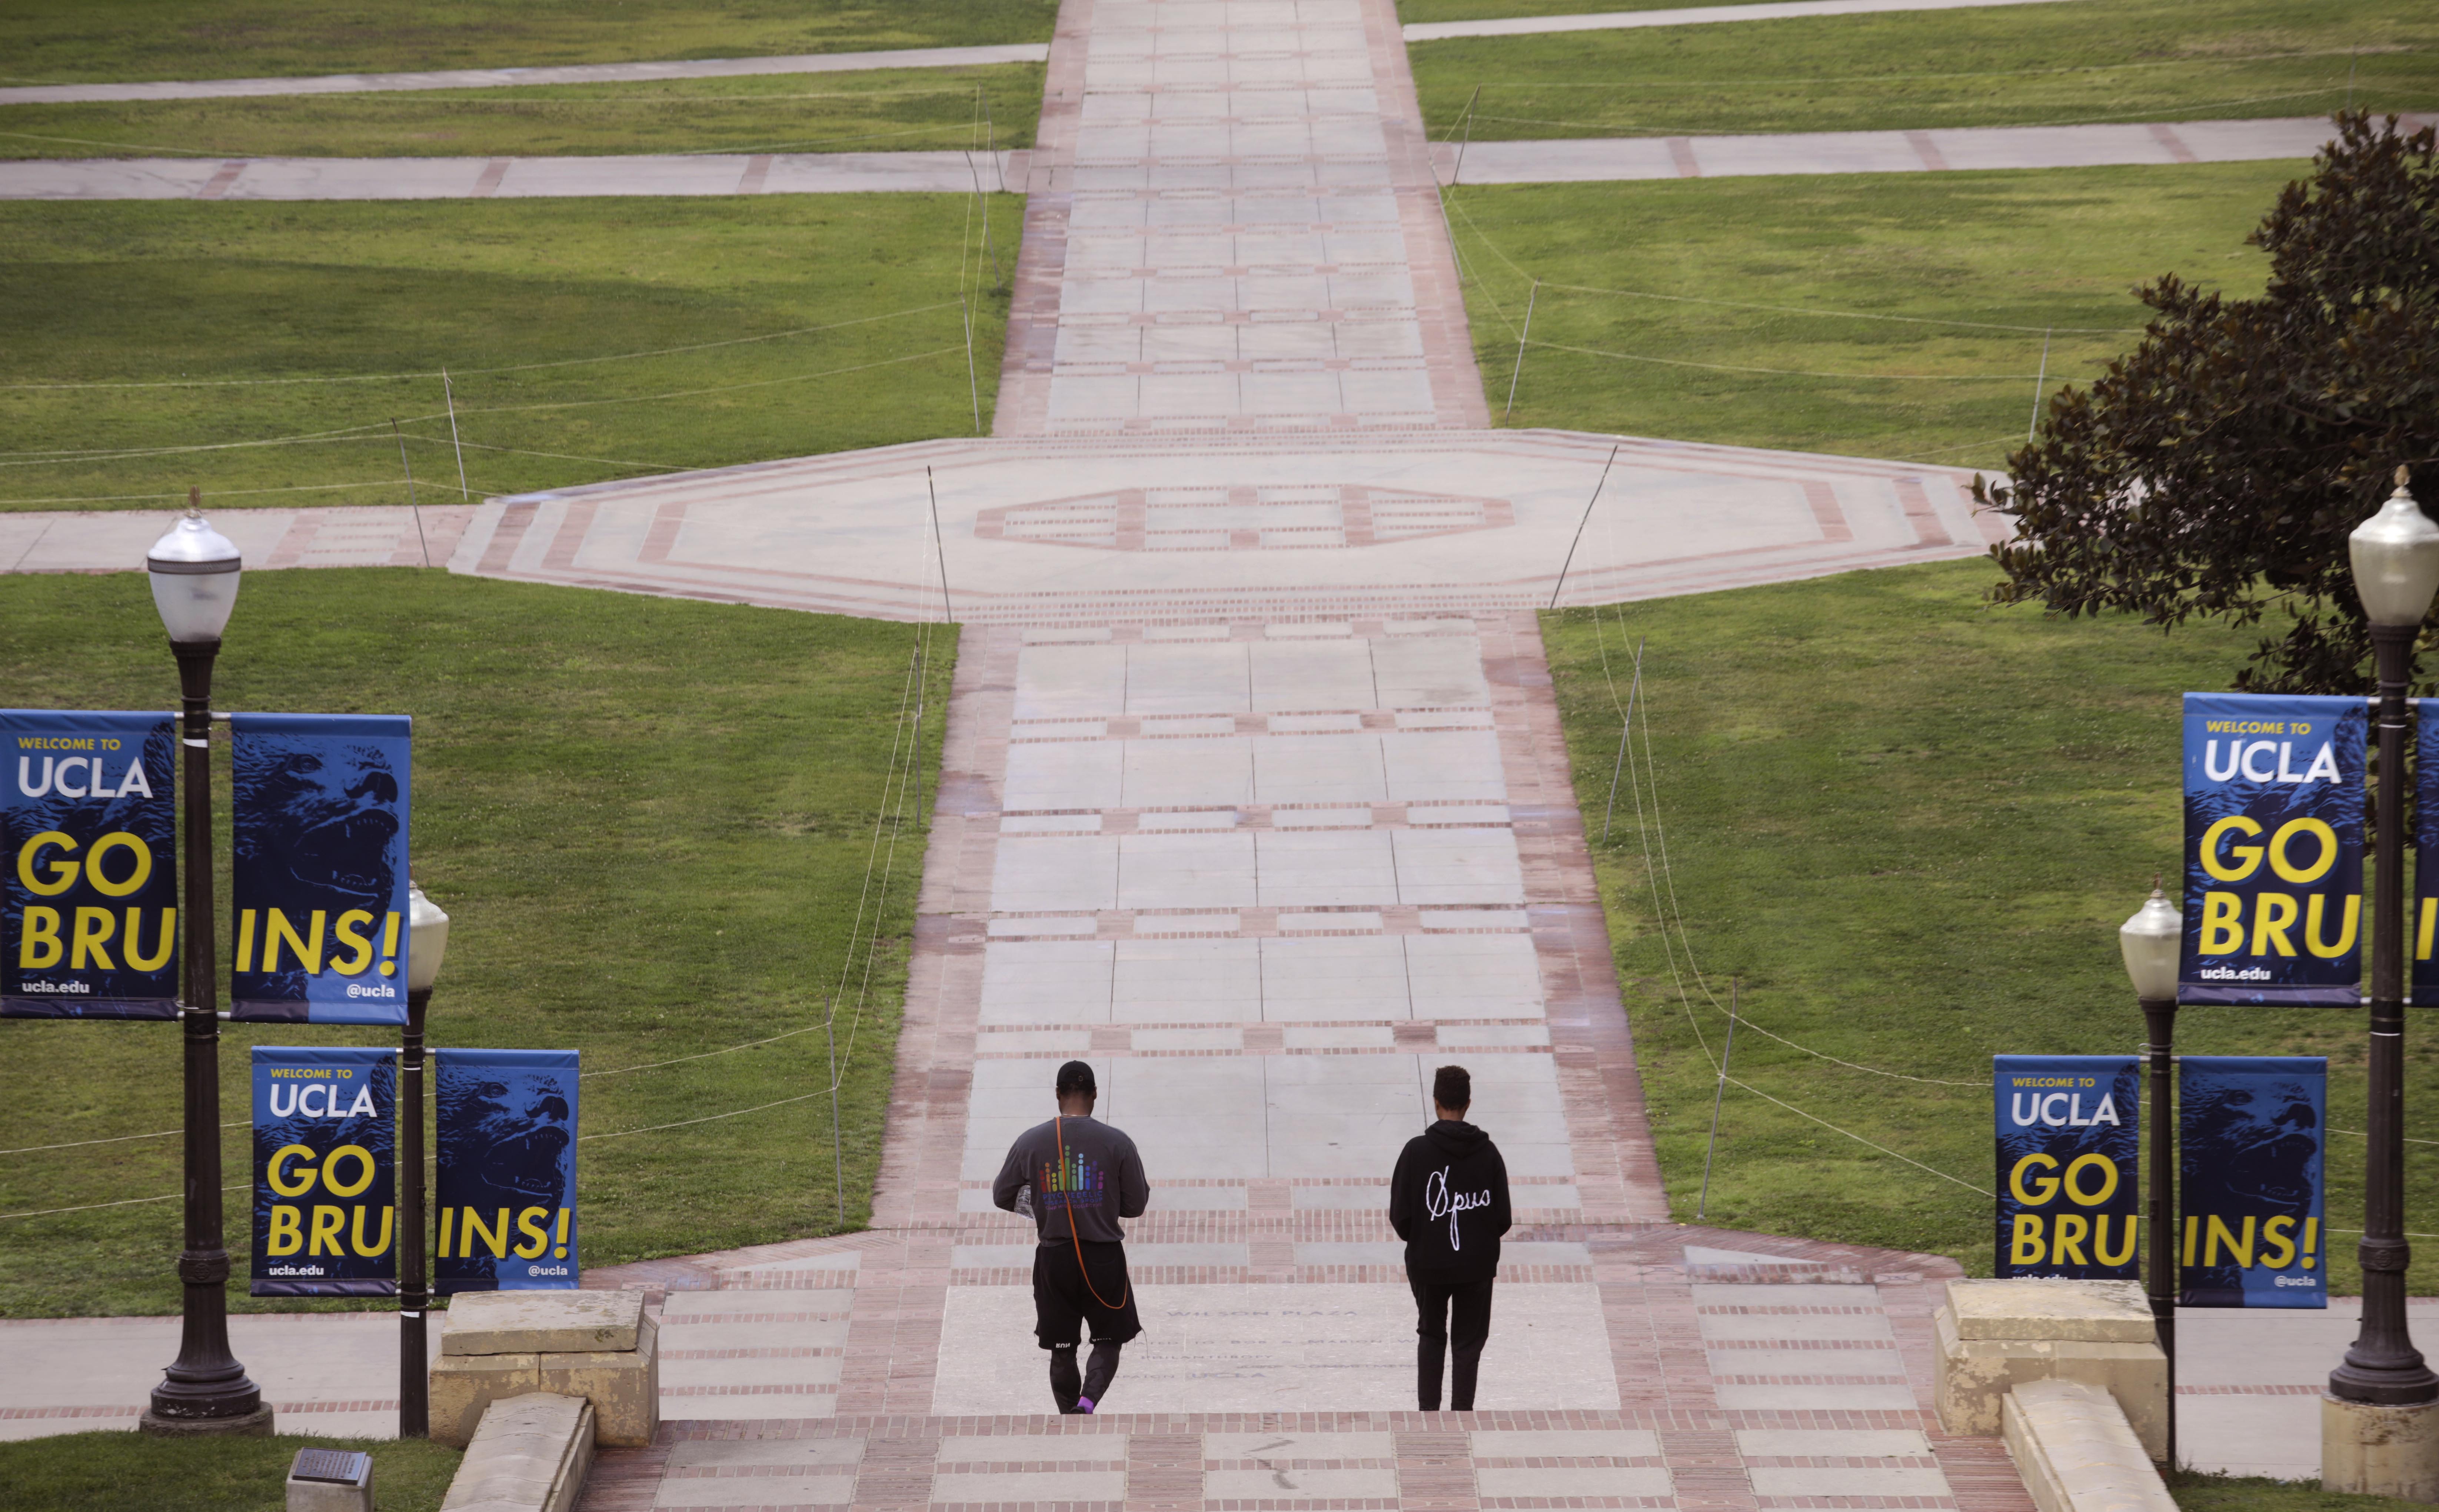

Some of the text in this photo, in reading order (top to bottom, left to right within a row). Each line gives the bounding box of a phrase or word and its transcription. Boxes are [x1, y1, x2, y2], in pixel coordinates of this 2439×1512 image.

[2207, 721, 2311, 735] WELCOME TO
[19, 737, 121, 750] WELCOME TO
[2204, 739, 2342, 784] UCLA
[18, 756, 153, 798] UCLA
[2200, 815, 2338, 884] GO
[17, 830, 152, 897] GO
[2200, 966, 2272, 980] ucla.edu
[22, 980, 90, 993] ucla.edu
[346, 983, 396, 999] @ucla
[271, 1069, 353, 1079] WELCOME TO
[2013, 1078, 2095, 1088] WELCOME TO
[270, 1083, 377, 1118] UCLA
[2011, 1092, 2120, 1127] UCLA
[267, 1144, 376, 1198] GO
[2009, 1153, 2119, 1206] GO
[1043, 1190, 1103, 1199] PYCHEDELIC
[269, 1265, 324, 1276] ucla.edu
[528, 1265, 568, 1277] @ucla
[2274, 1275, 2316, 1288] @ucla
